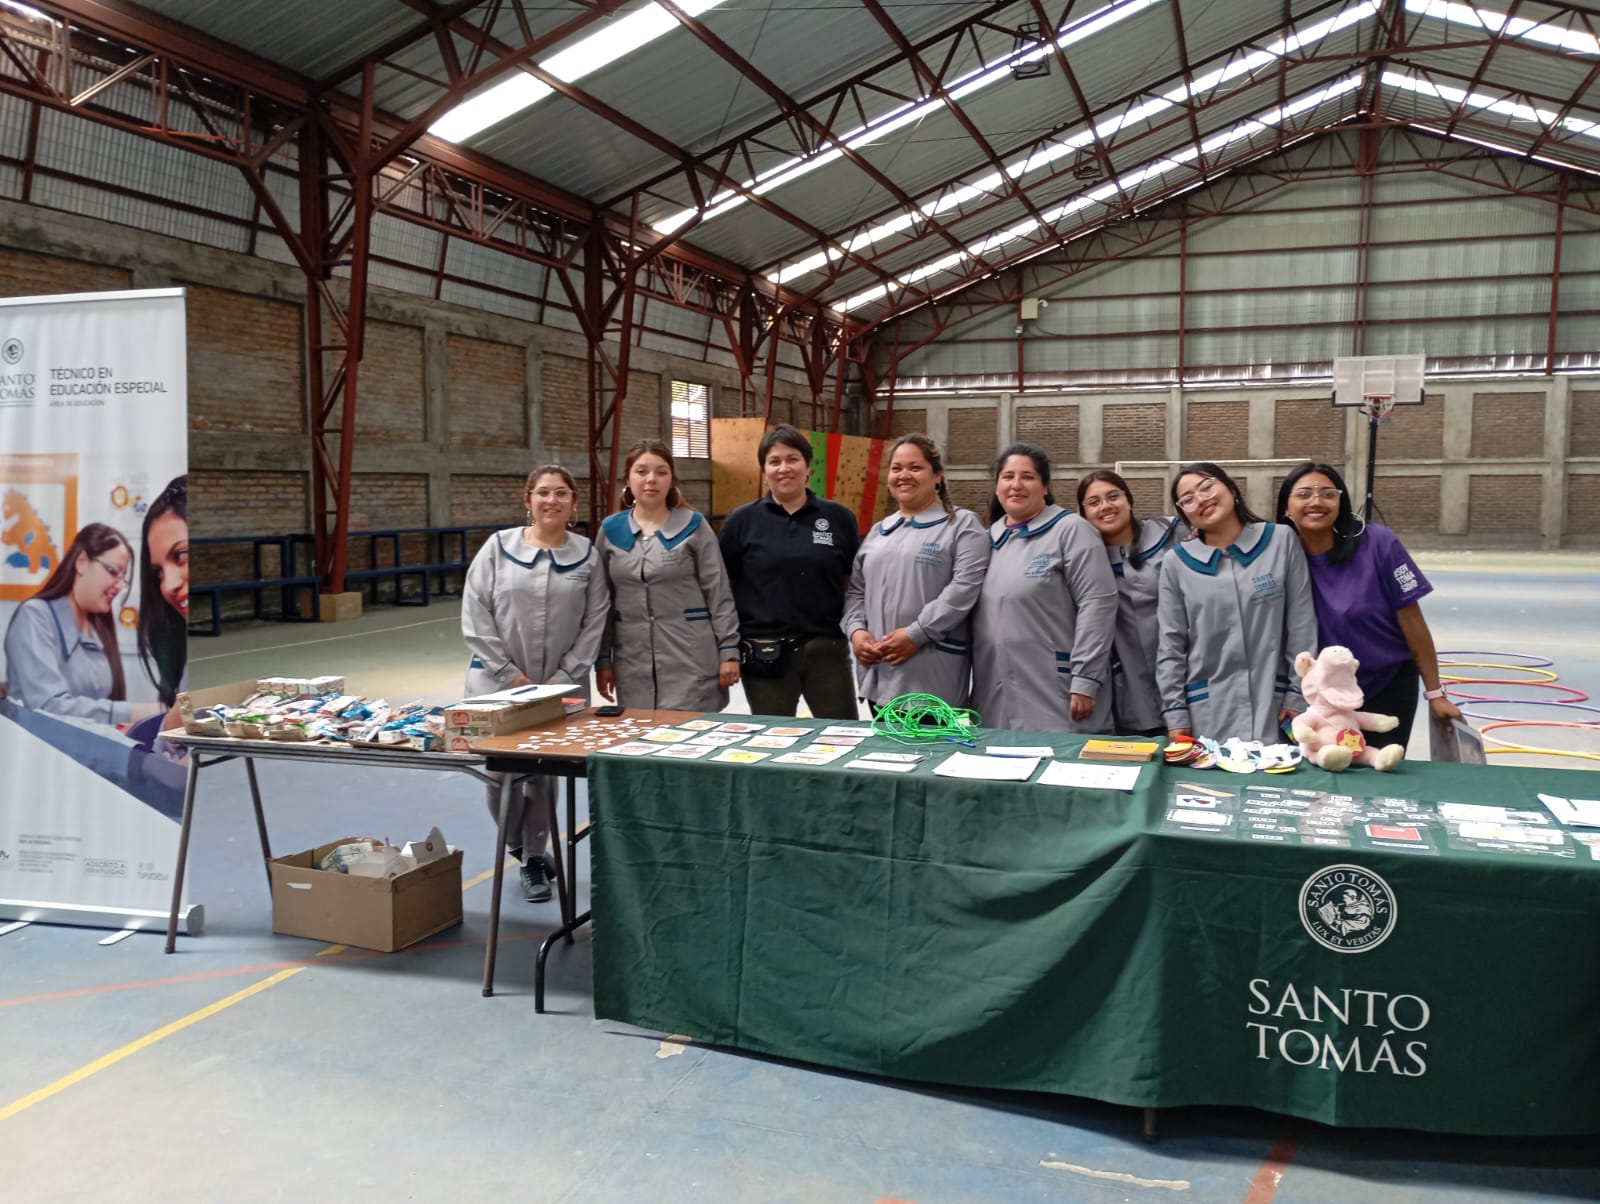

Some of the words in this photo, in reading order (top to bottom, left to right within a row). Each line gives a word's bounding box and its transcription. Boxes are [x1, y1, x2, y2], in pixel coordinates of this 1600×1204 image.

[0, 373, 35, 386] ANTO
[50, 367, 95, 380] TÉCNICO
[98, 367, 113, 379] EN
[0, 386, 35, 400] OMÁS
[50, 381, 111, 396] EDUCACIÓN
[114, 381, 168, 394] ESPECIAL
[1307, 872, 1345, 908] SANTO
[1348, 872, 1390, 914] TOMÁS
[1312, 921, 1330, 938] LUX
[1330, 935, 1344, 945] ET
[1345, 925, 1382, 946] VERITAS
[1247, 978, 1431, 1032] SANTO
[1246, 1021, 1428, 1078] TOMÁS
